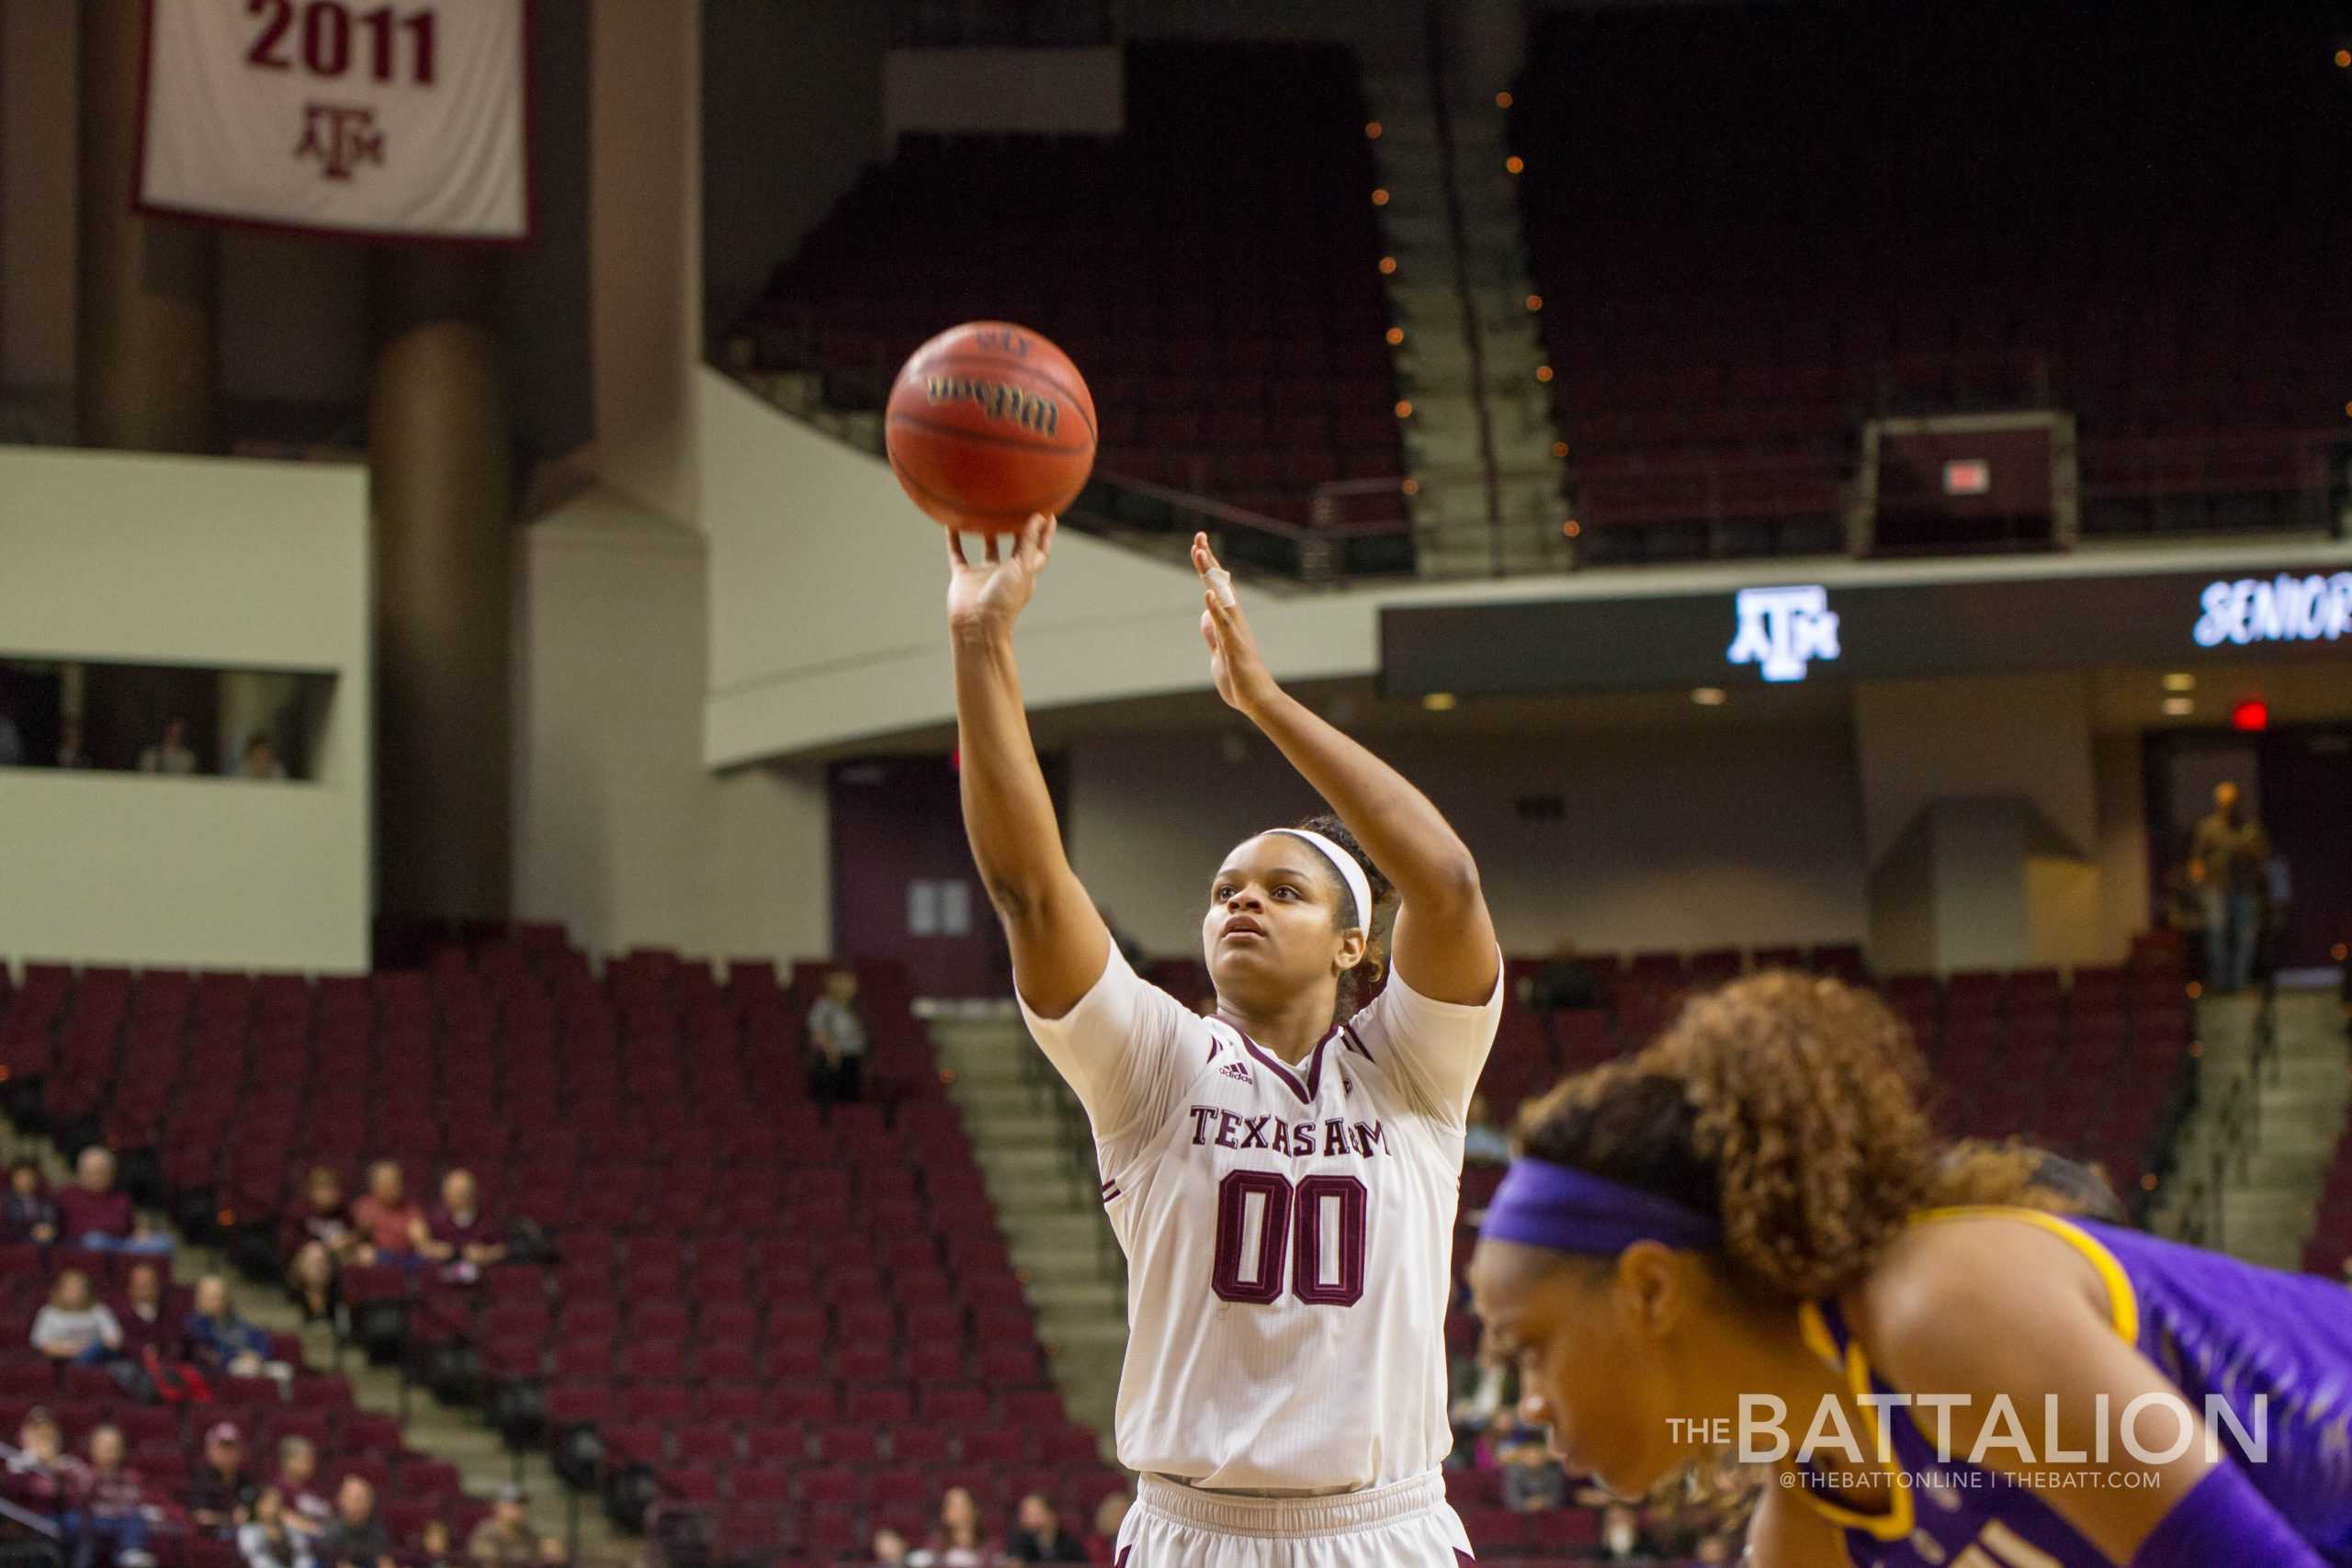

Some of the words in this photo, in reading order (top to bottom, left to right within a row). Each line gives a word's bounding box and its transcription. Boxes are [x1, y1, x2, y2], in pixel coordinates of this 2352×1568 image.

[245, 0, 436, 85] 2011
[1218, 1066, 1253, 1086] adidas
[1190, 1104, 1317, 1158] TEXAS
[1212, 1168, 1368, 1307] 00
